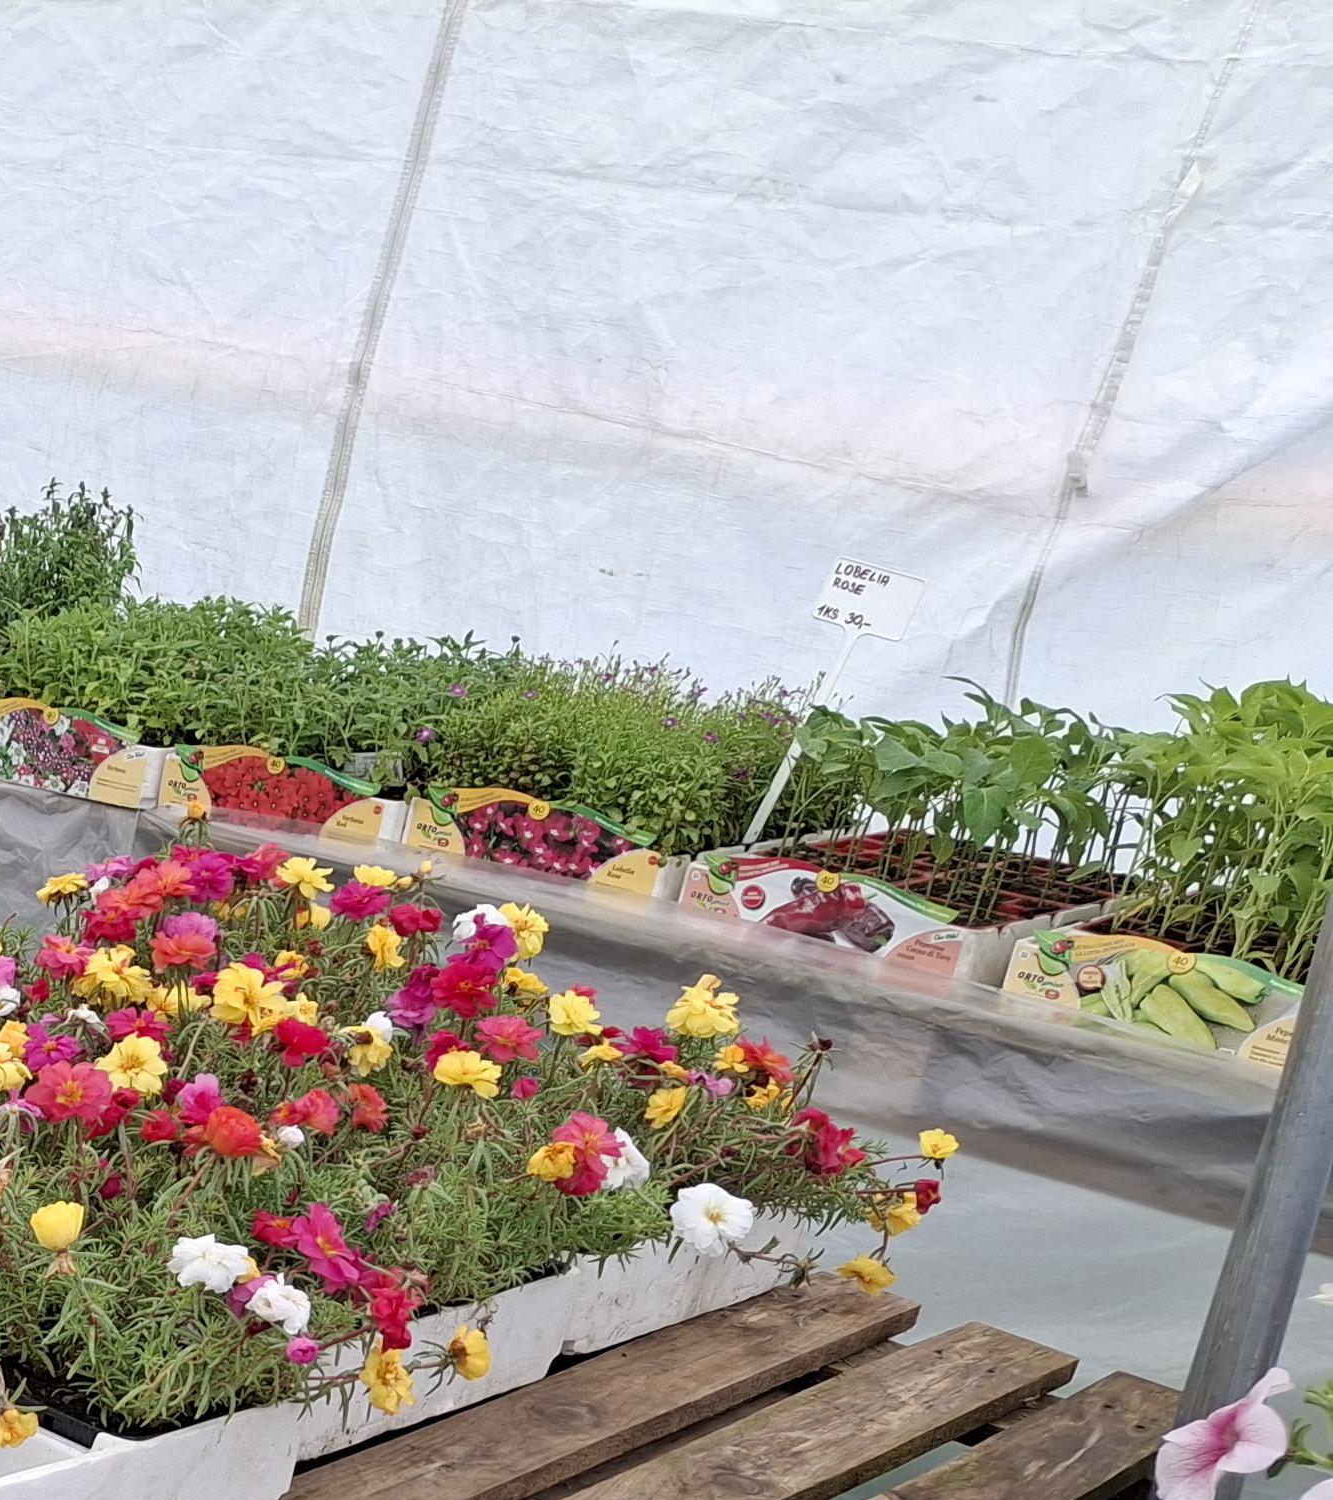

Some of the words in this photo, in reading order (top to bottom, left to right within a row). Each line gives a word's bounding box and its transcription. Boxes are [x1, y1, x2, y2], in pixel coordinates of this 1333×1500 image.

[834, 562, 891, 587] LOBELIA
[832, 577, 866, 596] ROSE
[817, 604, 840, 620] 1KS
[844, 612, 872, 630] 30,-
[416, 822, 437, 833] ORTO
[822, 875, 833, 885] 40
[690, 891, 713, 902] ORTO
[1173, 955, 1189, 966] 40
[1017, 971, 1045, 984] ORTO
